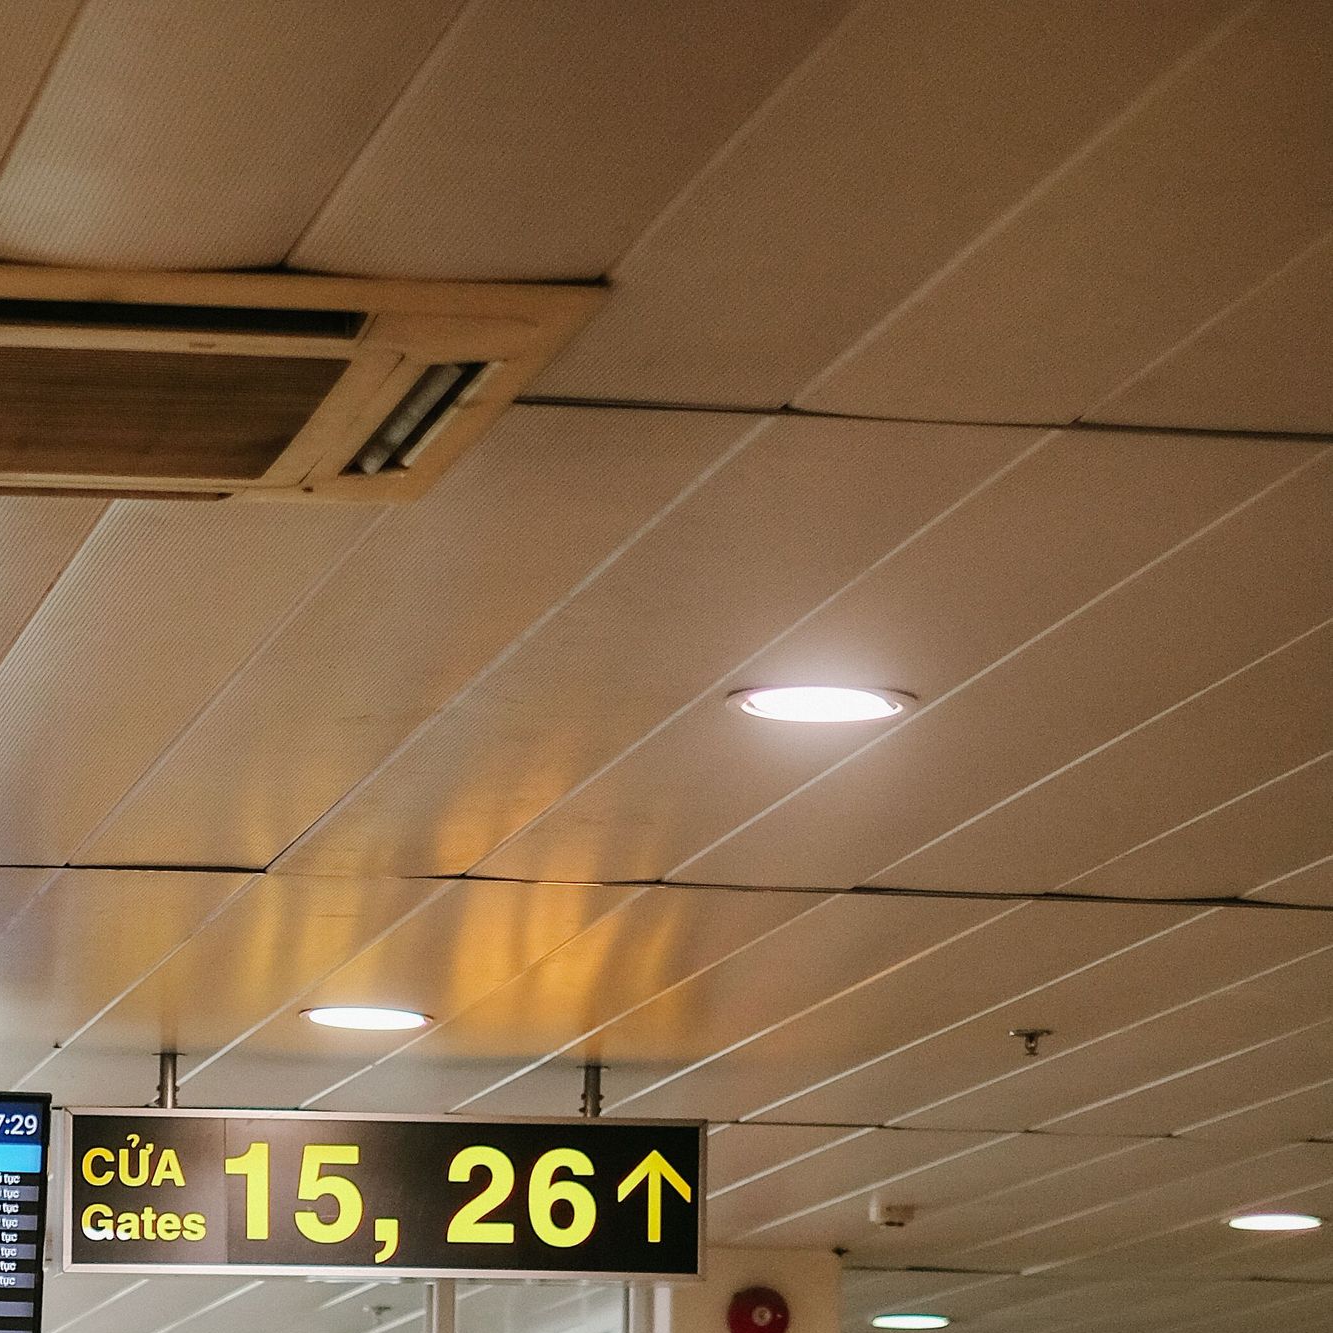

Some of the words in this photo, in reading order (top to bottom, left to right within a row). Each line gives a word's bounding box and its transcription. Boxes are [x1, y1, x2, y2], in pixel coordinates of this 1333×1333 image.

[81, 1134, 185, 1188] CỬA
[81, 1203, 206, 1241] Gates
[224, 1142, 399, 1264] 15,
[447, 1146, 597, 1248] 26
